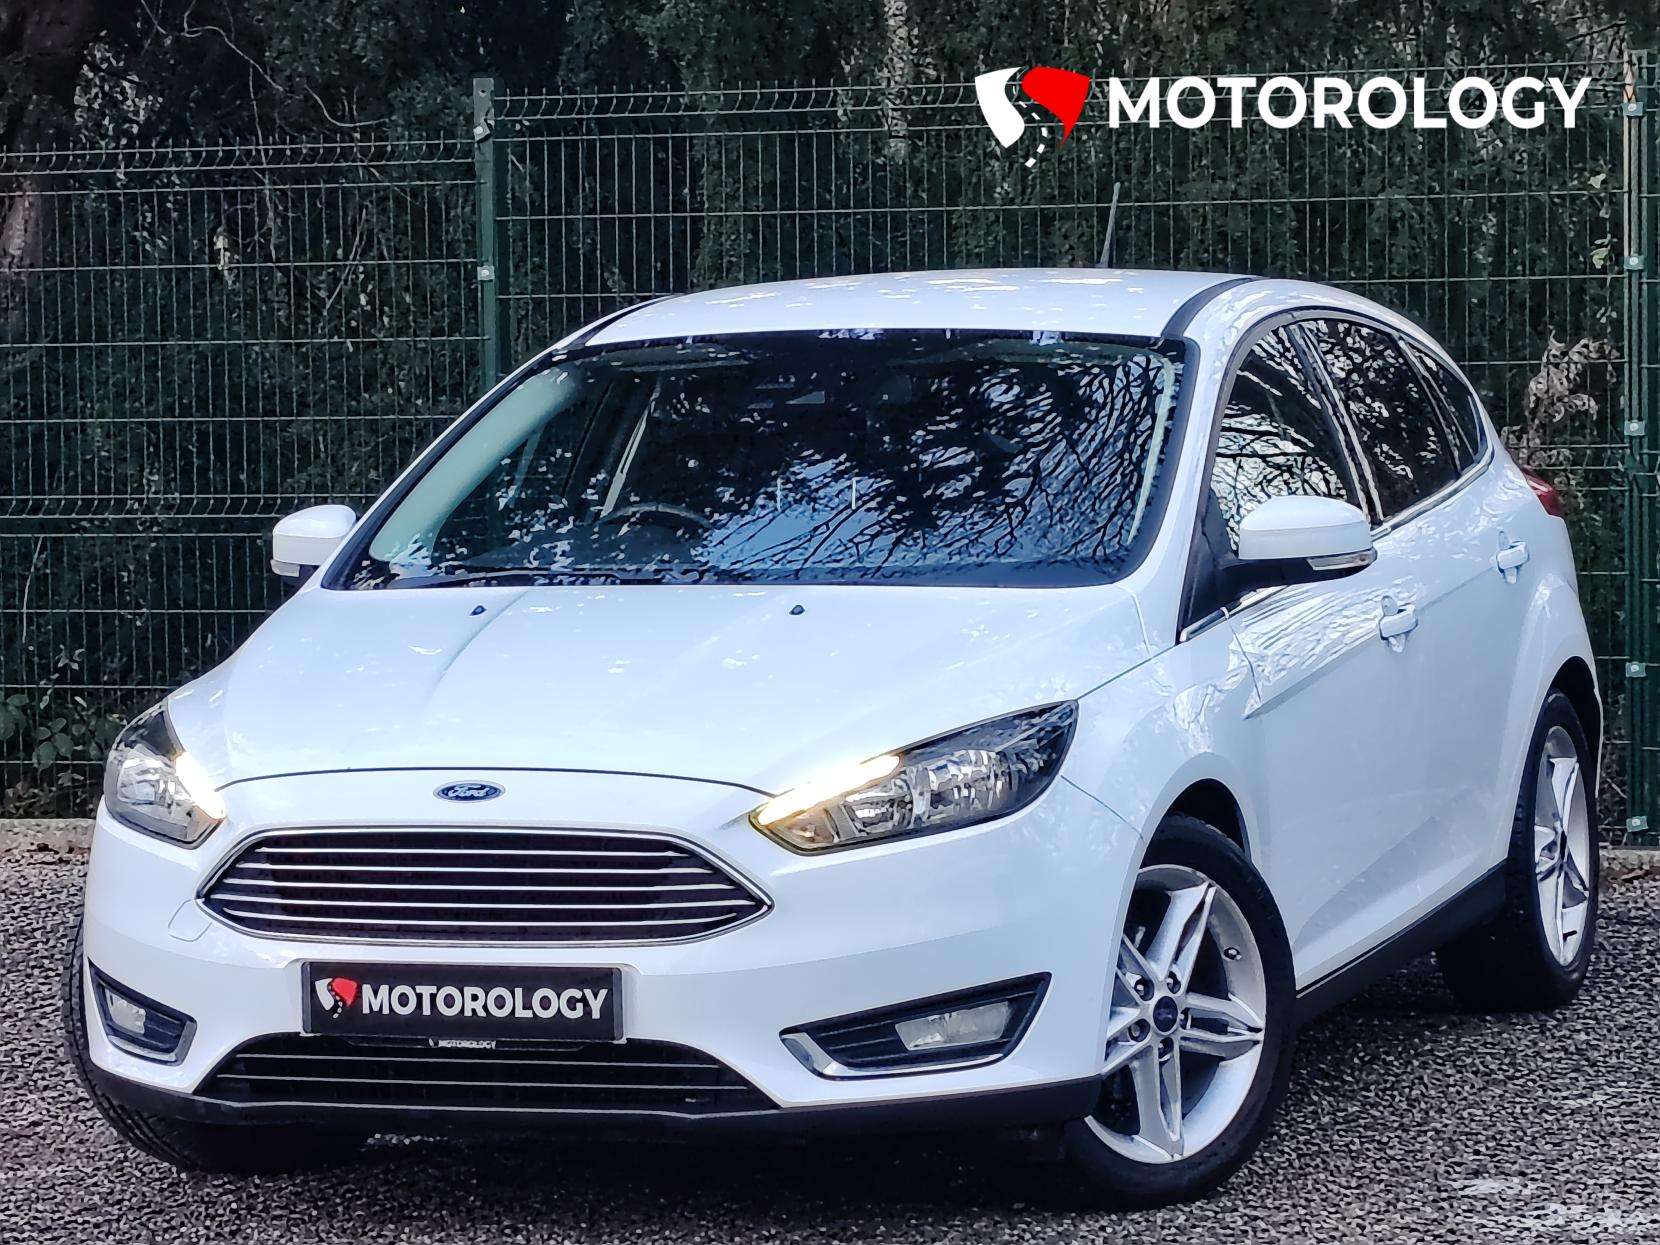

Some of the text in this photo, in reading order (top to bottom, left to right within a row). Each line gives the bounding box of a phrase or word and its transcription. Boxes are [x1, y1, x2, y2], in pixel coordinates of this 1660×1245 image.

[447, 784, 490, 798] Ford
[362, 984, 608, 1019] MOTOROLOGY
[438, 1039, 496, 1049] MOTOROLOGY
